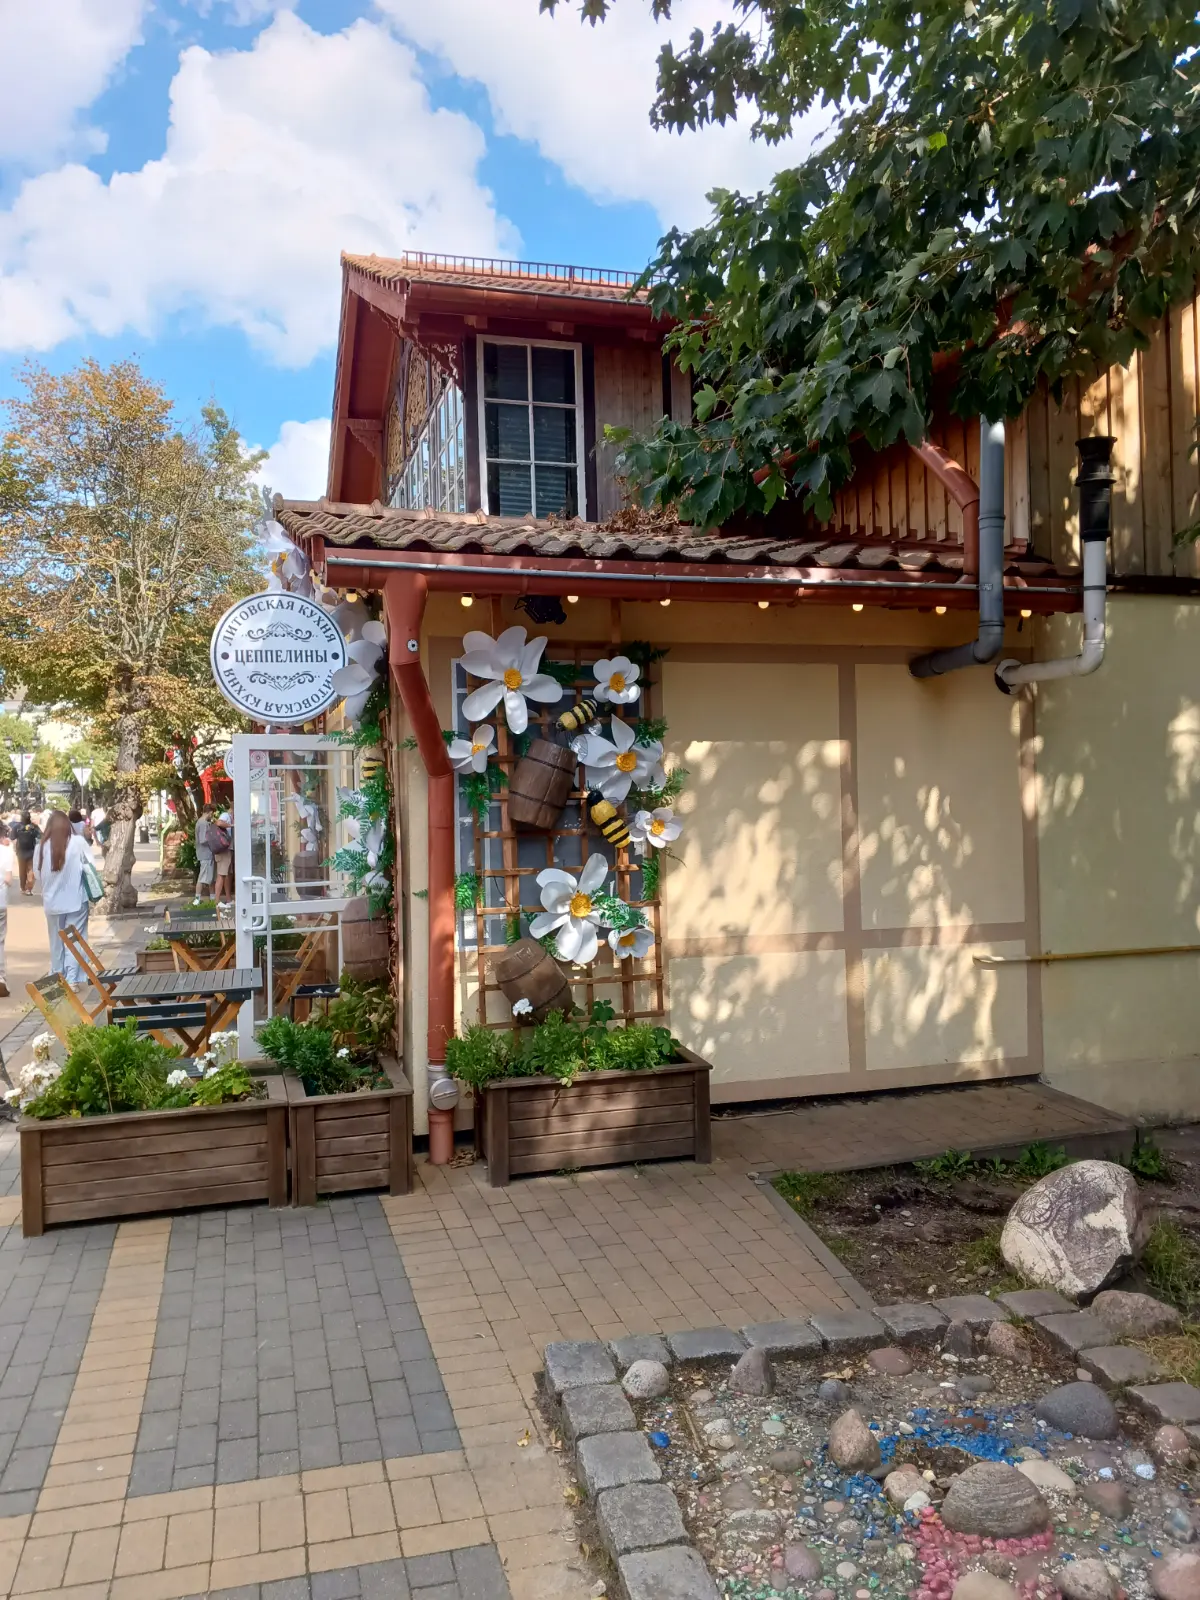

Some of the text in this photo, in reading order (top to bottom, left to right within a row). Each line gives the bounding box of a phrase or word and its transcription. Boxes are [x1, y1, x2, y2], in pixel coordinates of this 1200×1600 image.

[223, 599, 337, 646] ЛИТОВСКАЯ КУХНЯ
[234, 649, 328, 666] ЦЕППЕЛИНЫ
[223, 668, 262, 706] КУХНЯ
